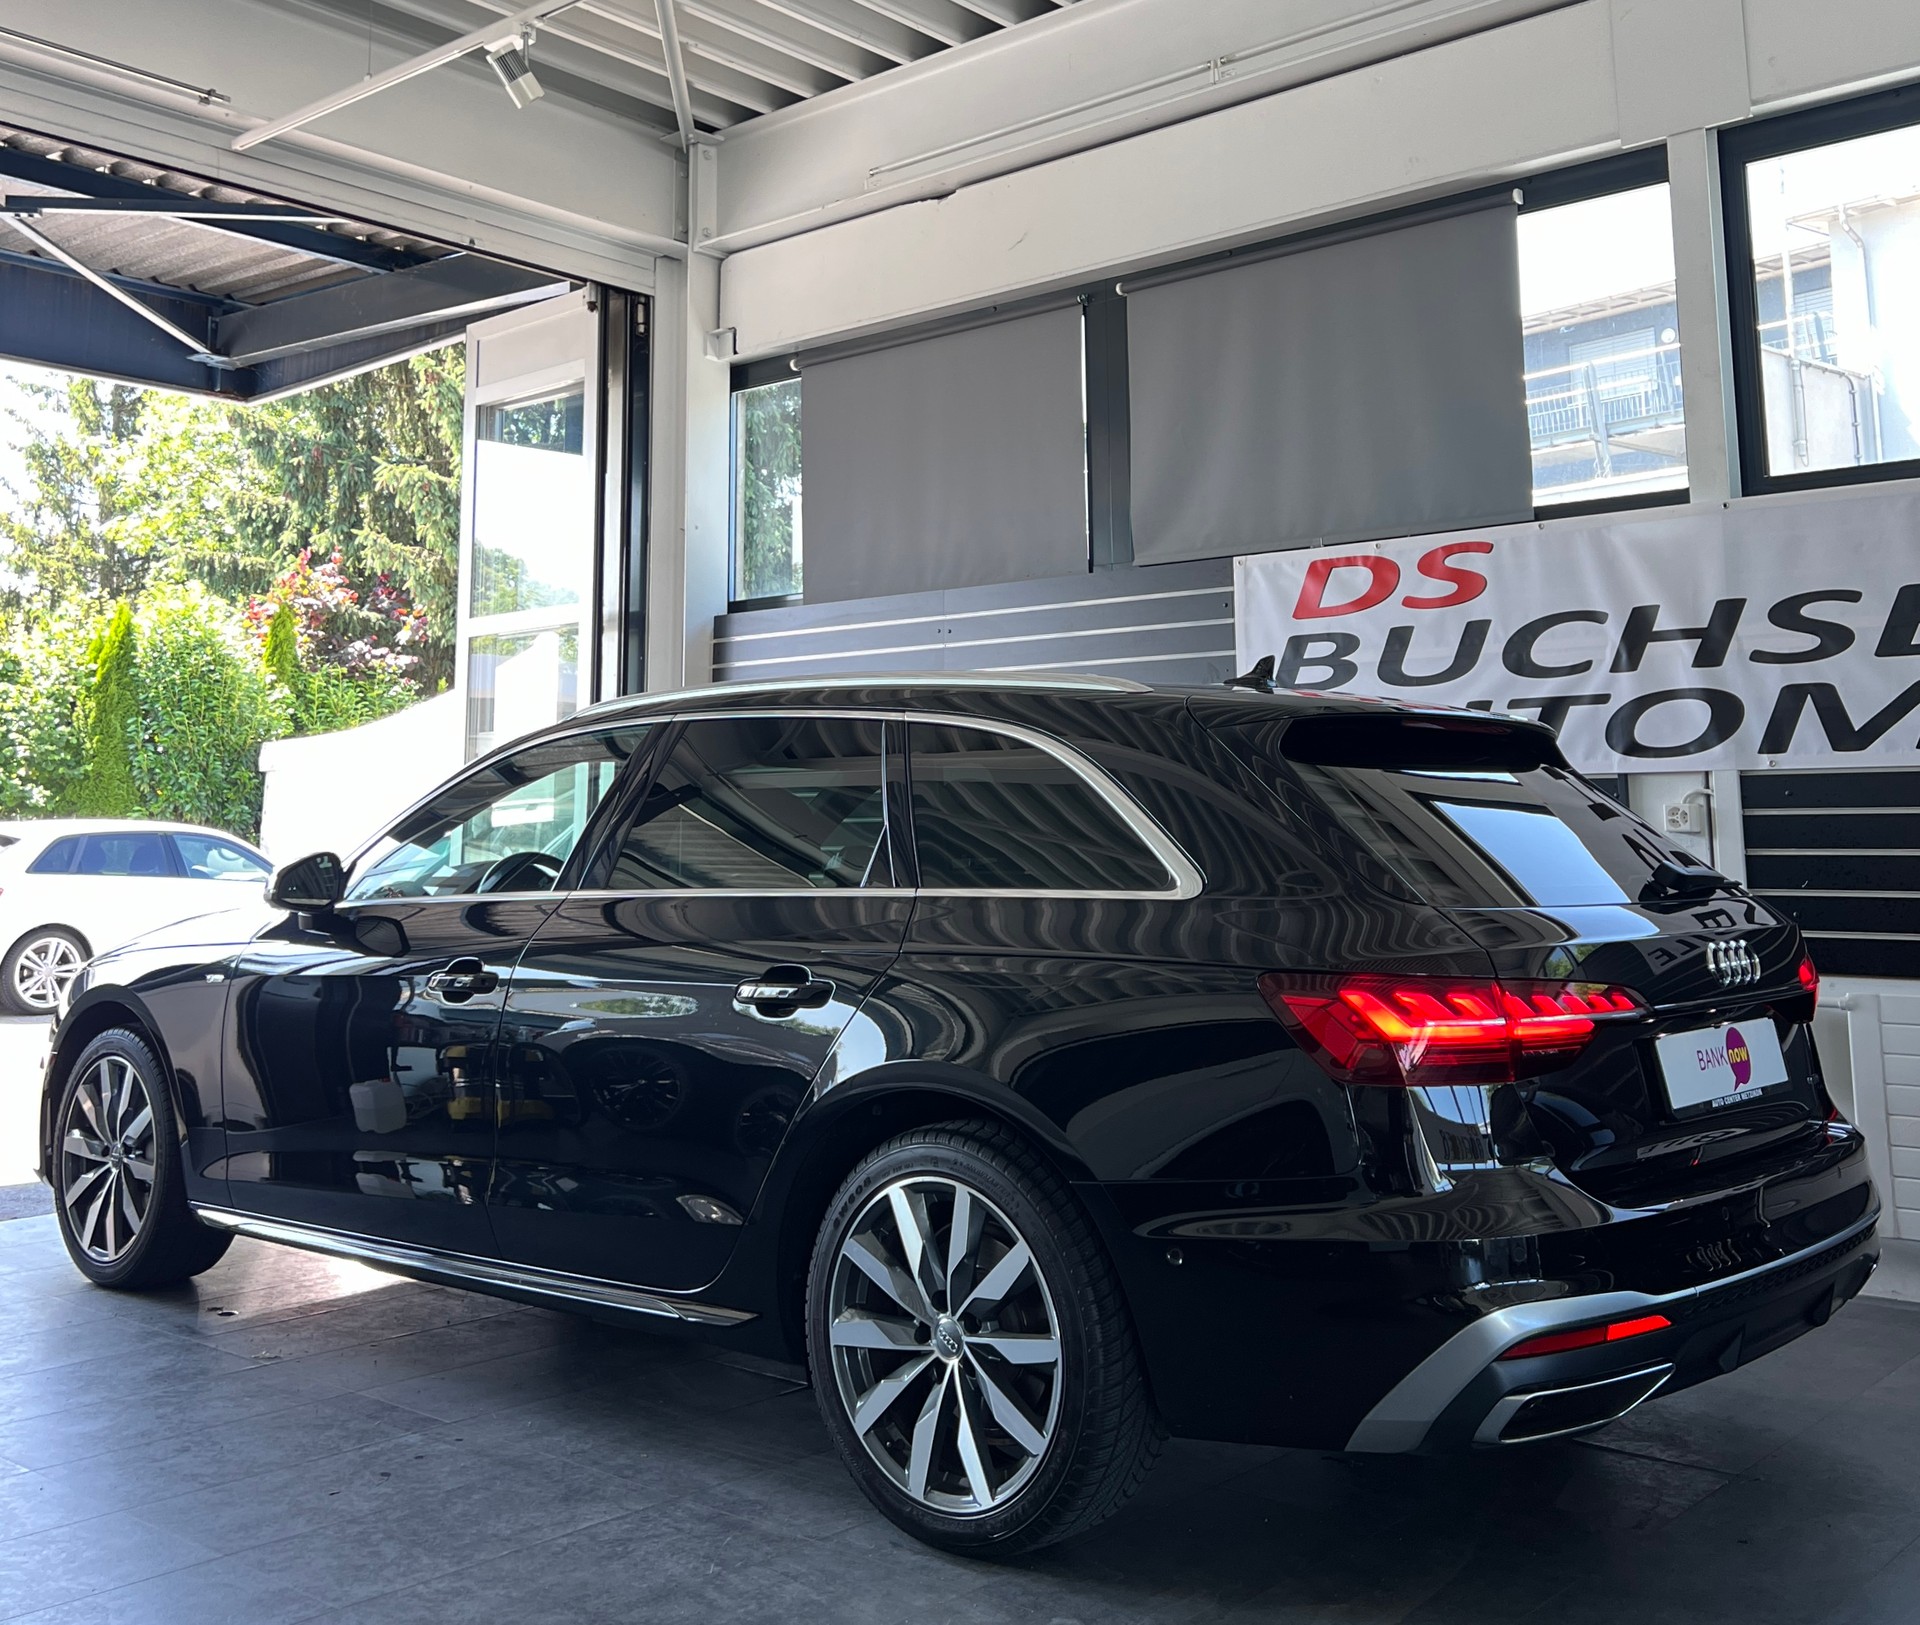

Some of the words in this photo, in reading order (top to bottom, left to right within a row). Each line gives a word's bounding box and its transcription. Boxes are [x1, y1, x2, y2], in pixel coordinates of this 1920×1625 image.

[1292, 541, 1494, 620] DS
[1696, 1046, 1728, 1071] BANK
[1728, 1046, 1748, 1064] now
